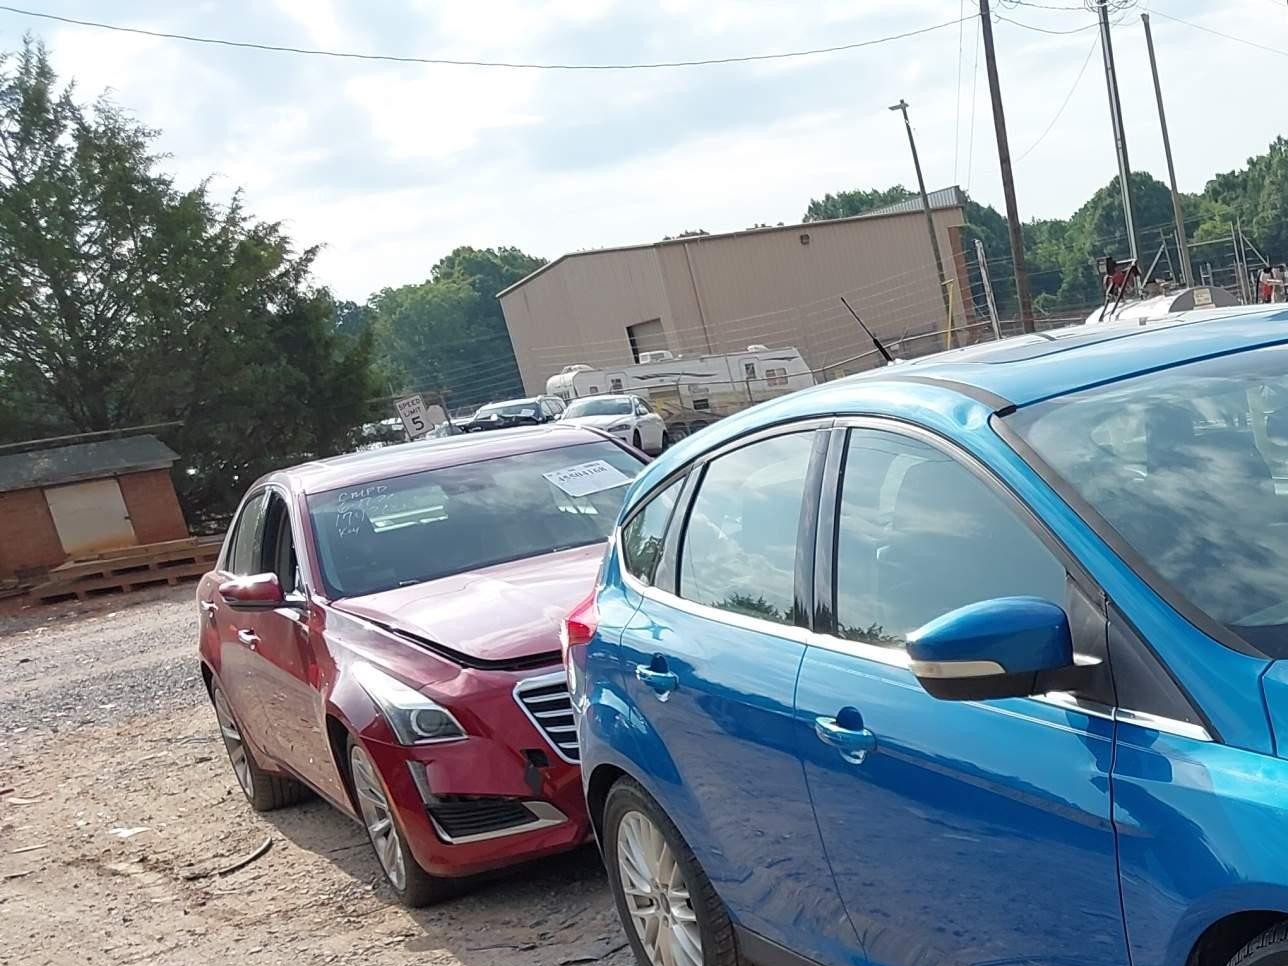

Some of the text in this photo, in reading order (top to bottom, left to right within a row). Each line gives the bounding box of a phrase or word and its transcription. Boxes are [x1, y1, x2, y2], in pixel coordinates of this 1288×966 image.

[398, 398, 421, 411] SPEED
[403, 406, 422, 417] LIMIT
[411, 415, 425, 431] 5
